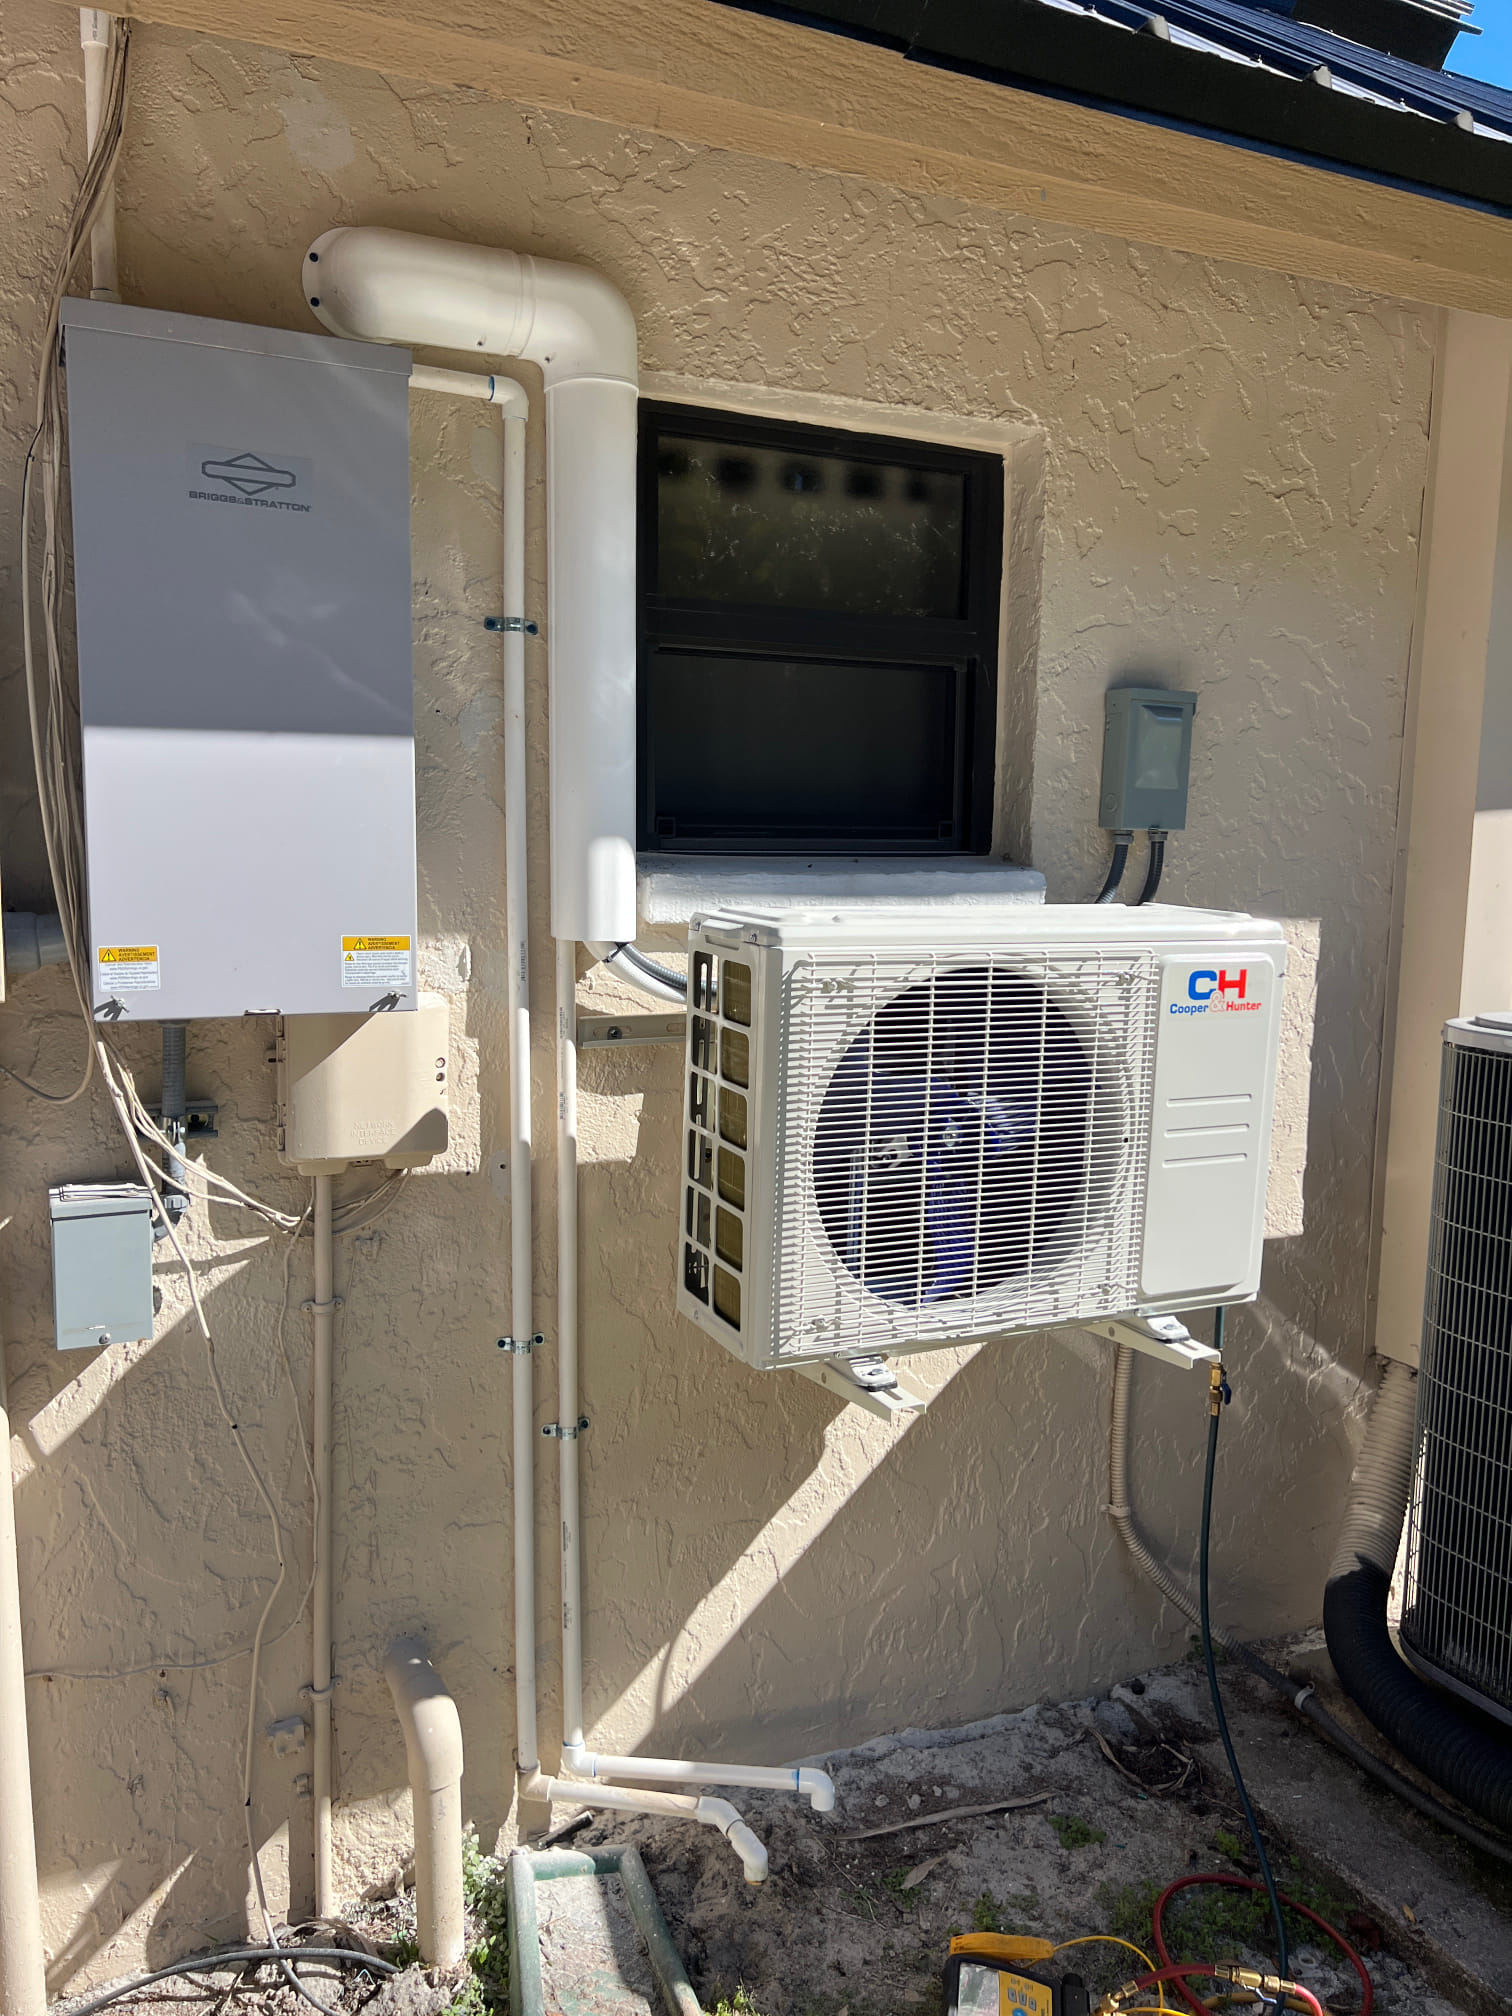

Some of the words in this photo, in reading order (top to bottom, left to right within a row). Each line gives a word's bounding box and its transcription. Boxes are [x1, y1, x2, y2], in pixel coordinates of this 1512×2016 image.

[1188, 969, 1247, 1001] CH
[1170, 1003, 1209, 1016] Cooper
[1226, 1001, 1262, 1012] Hunter
